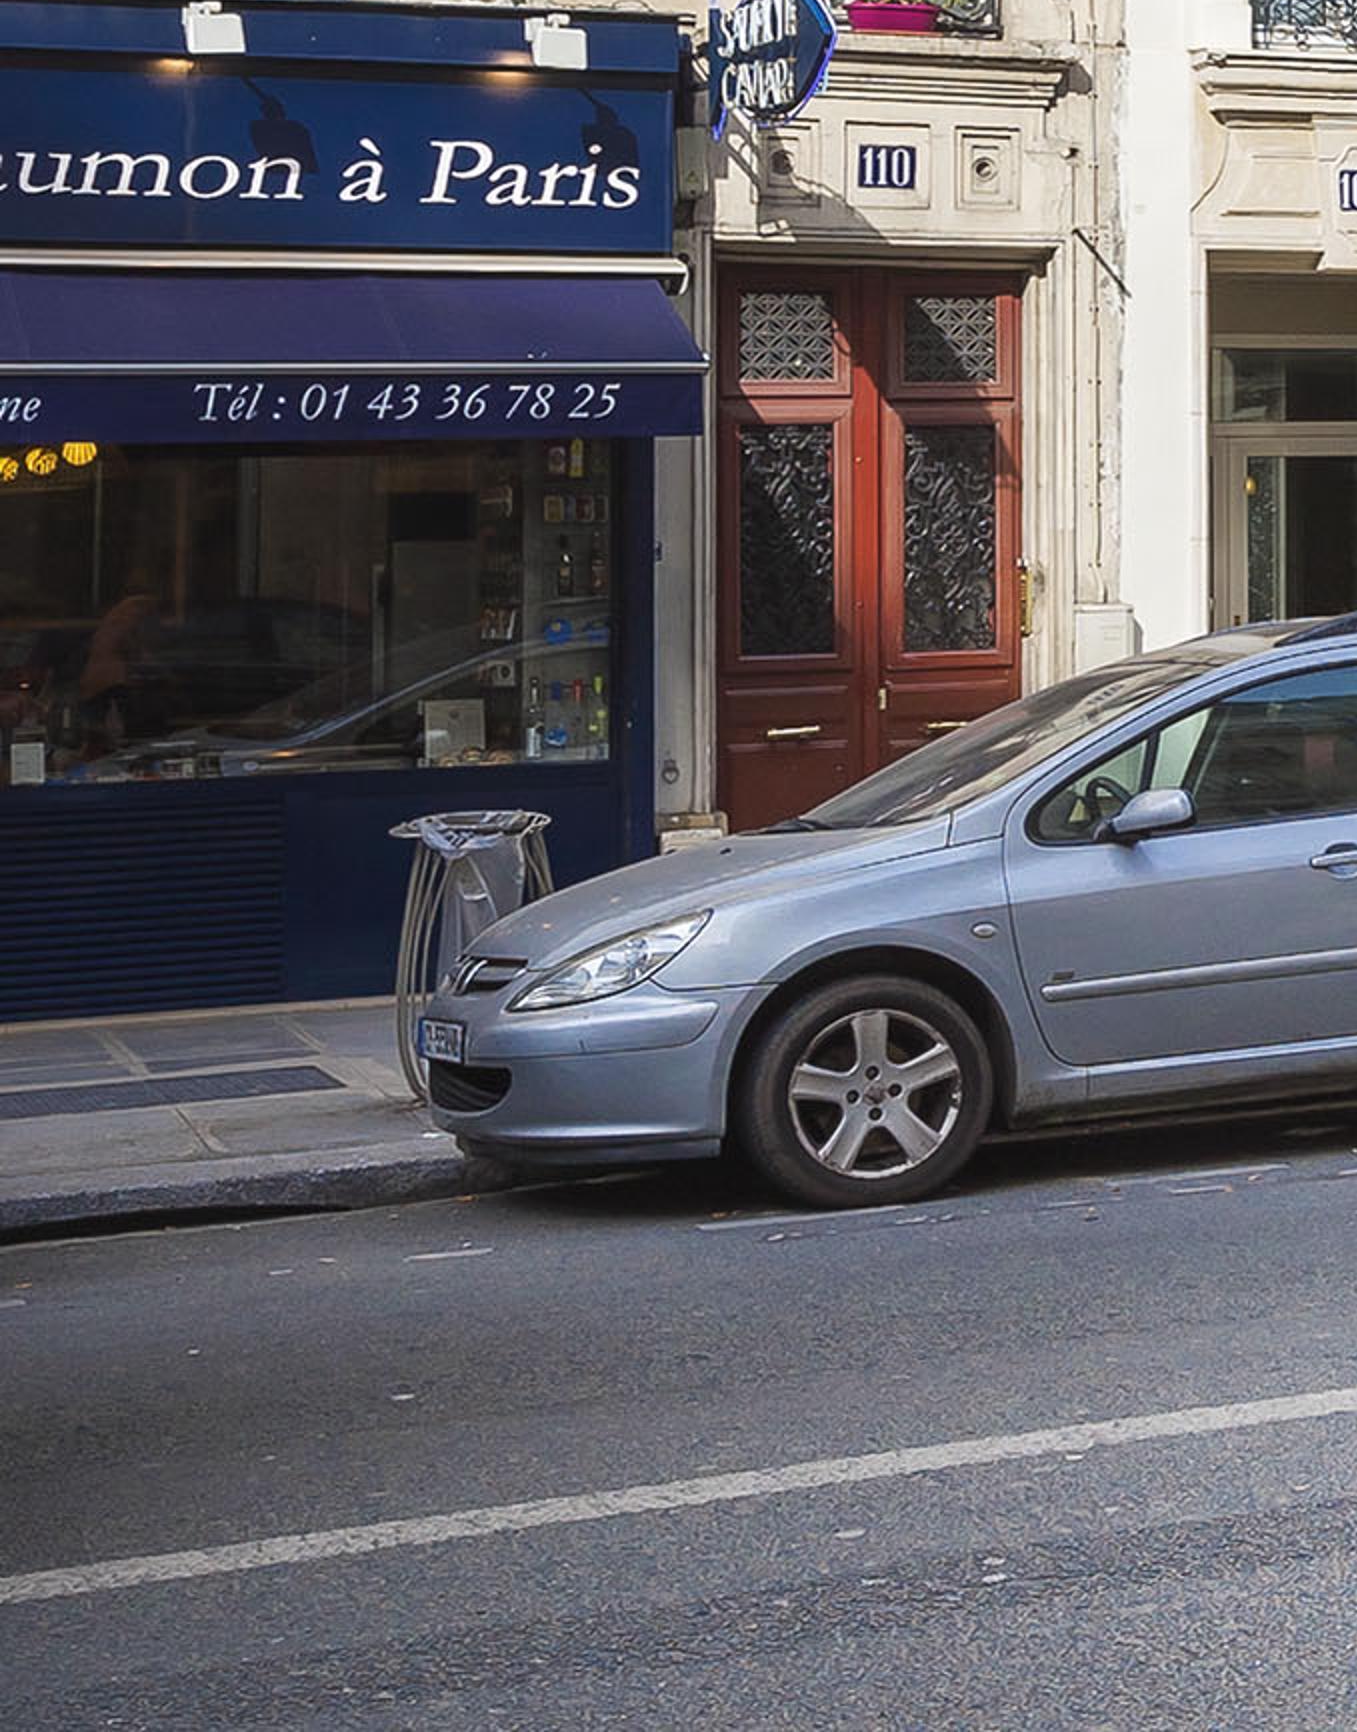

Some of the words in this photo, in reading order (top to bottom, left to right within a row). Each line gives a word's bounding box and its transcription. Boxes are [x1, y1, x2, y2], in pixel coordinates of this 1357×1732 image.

[0, 150, 304, 200] umon
[338, 137, 388, 204] à
[418, 139, 641, 209] Paris
[862, 147, 911, 187] 110
[193, 382, 265, 422] Tél
[299, 382, 350, 422] 01
[366, 382, 421, 421] 43
[435, 382, 491, 421] 36
[504, 382, 556, 421] 78
[567, 382, 621, 420] 25
